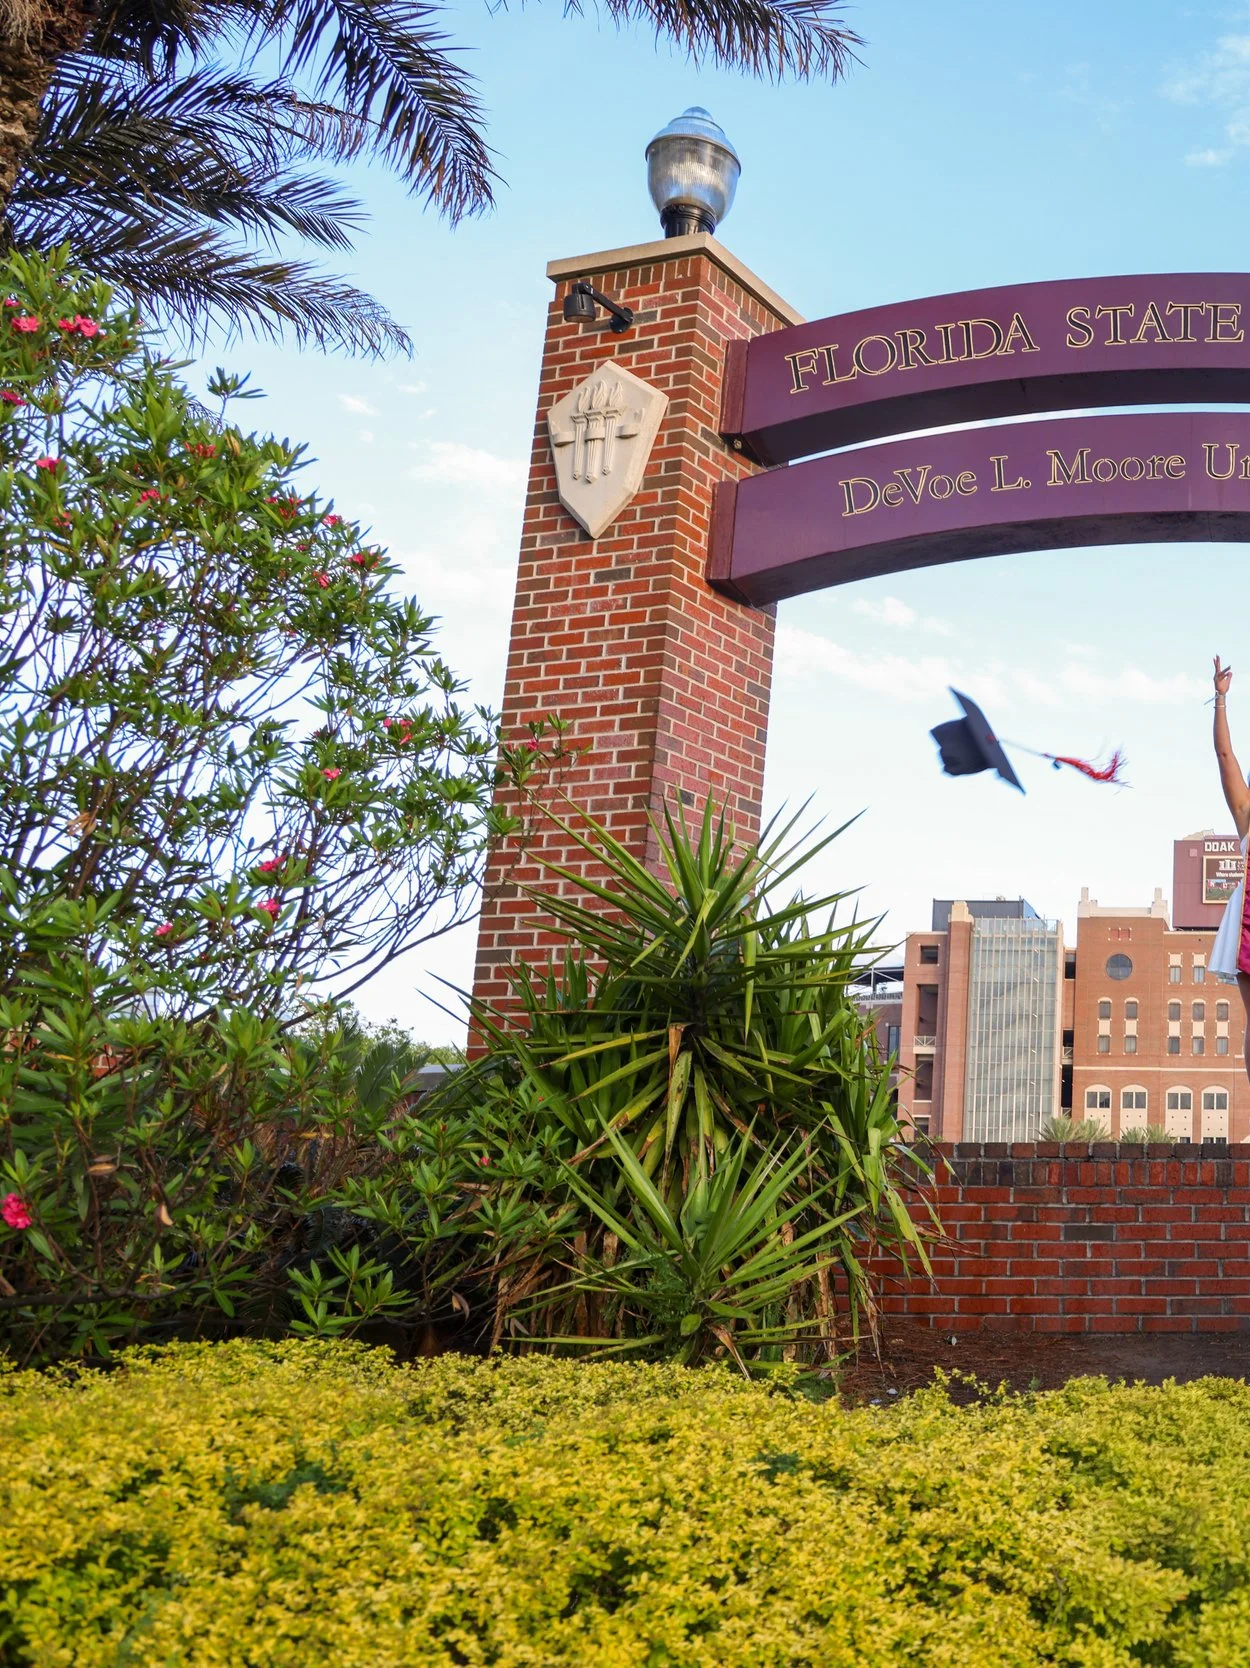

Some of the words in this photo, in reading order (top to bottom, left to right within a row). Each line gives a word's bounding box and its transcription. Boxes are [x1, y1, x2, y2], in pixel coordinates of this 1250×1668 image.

[784, 313, 1040, 394] FLORIDA
[1066, 302, 1245, 347] STATE
[838, 465, 977, 516] DeVoe
[990, 455, 1032, 491] L.
[1046, 448, 1186, 486] Moore
[1204, 841, 1235, 852] DOAK
